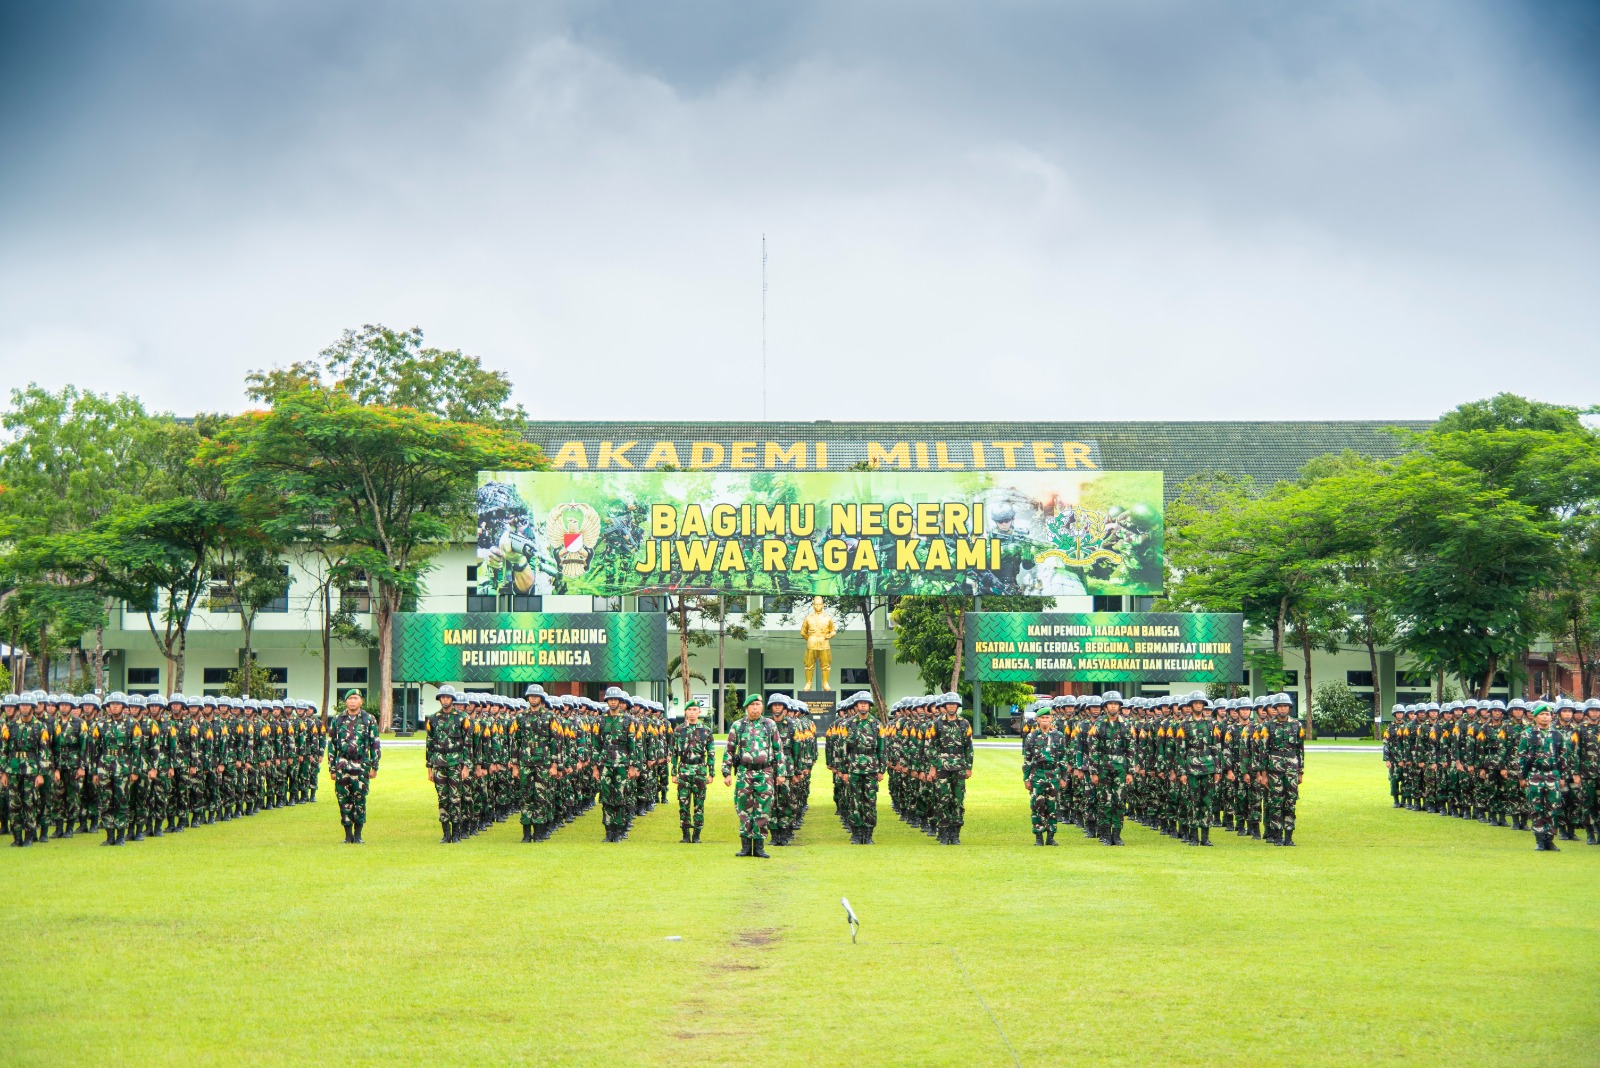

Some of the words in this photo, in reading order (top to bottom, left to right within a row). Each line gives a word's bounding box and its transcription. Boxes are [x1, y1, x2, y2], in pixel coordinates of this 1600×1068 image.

[552, 441, 827, 469] AKADEMI
[867, 441, 1098, 469] MILITER
[651, 502, 816, 538] BAGIMU
[830, 502, 984, 536] NEGERI
[635, 539, 747, 573] JIWA
[762, 538, 879, 572] RAGA
[895, 538, 1002, 571] KAMI
[444, 629, 477, 645] KAMI
[480, 629, 535, 645] KSATRIA
[538, 628, 607, 644] PETARUNG
[1028, 625, 1052, 637] KAMI
[1054, 625, 1092, 637] PEMUDA
[1095, 625, 1140, 637] HARAPAN
[1142, 625, 1180, 637] BANGSA
[976, 641, 1015, 653] KSATRIA
[1017, 641, 1042, 653] YANG
[1044, 641, 1083, 654] CERDAS,
[1085, 641, 1133, 654] BERGUNA,
[1135, 641, 1197, 654] BERMANFAAT
[1199, 641, 1231, 654] UNTUK
[462, 650, 536, 666] PELINDUNG
[538, 650, 592, 666] BANGSA
[992, 658, 1033, 670] BANGSA,
[1036, 658, 1076, 670] NEGARA,
[1078, 658, 1141, 670] MASYARAKAT
[1143, 658, 1162, 670] DAN
[1164, 658, 1215, 670] KELUARGA
